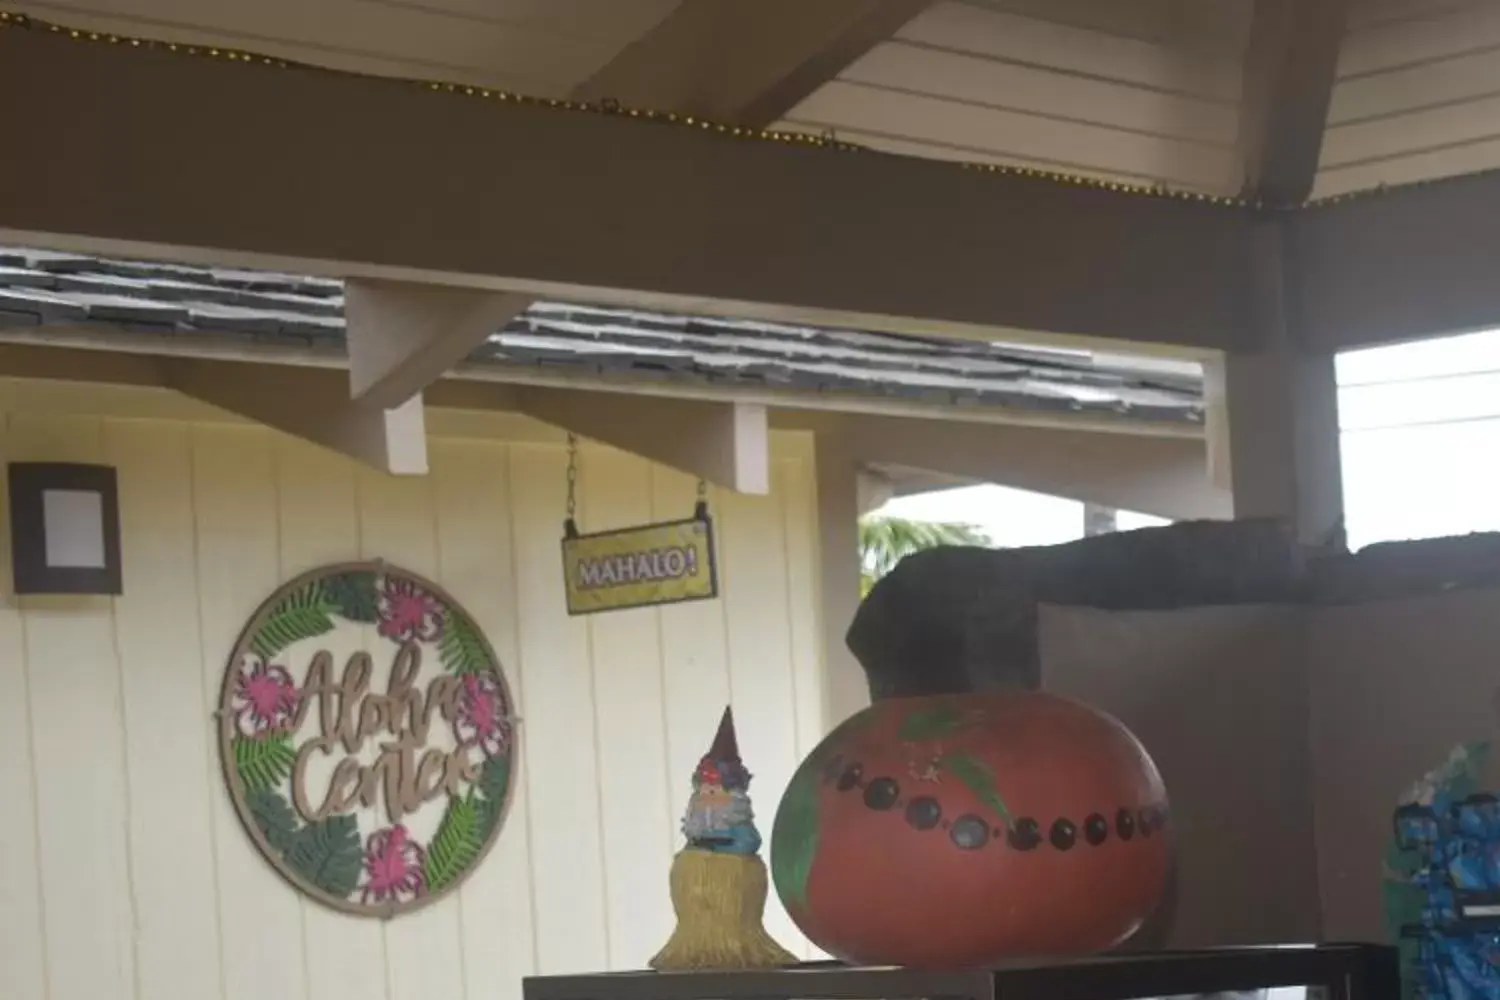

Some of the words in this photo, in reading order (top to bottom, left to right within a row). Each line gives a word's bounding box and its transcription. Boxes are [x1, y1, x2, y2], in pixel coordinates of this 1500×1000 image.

[578, 546, 697, 587] MAHALO!
[290, 643, 463, 753] Aloha
[292, 735, 482, 824] Center
